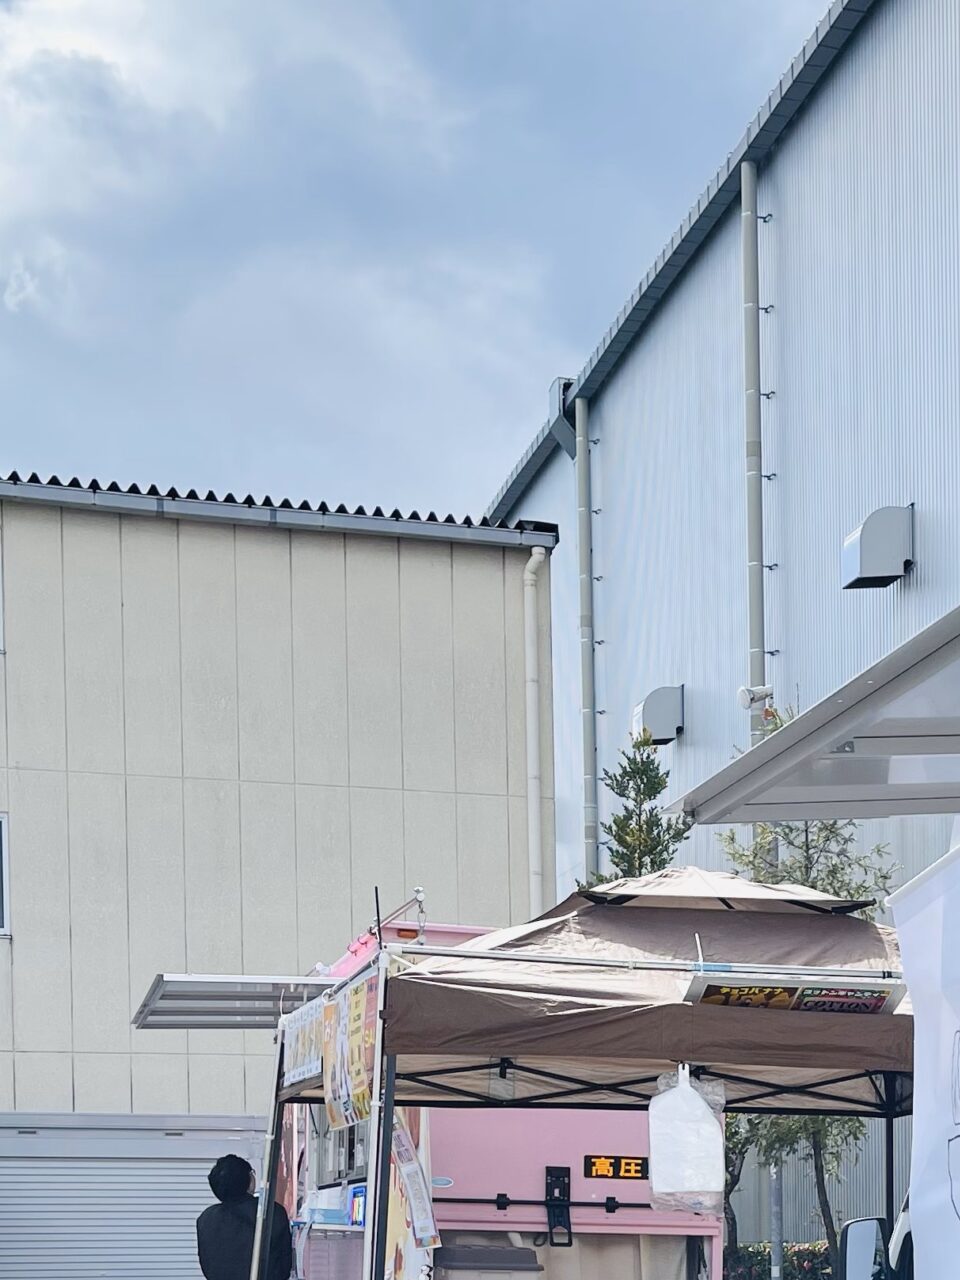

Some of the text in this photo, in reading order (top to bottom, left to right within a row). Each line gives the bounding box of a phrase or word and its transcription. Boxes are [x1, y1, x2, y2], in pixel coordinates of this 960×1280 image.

[719, 986, 784, 995] チョコバナナ
[590, 1157, 647, 1178] 高圧
